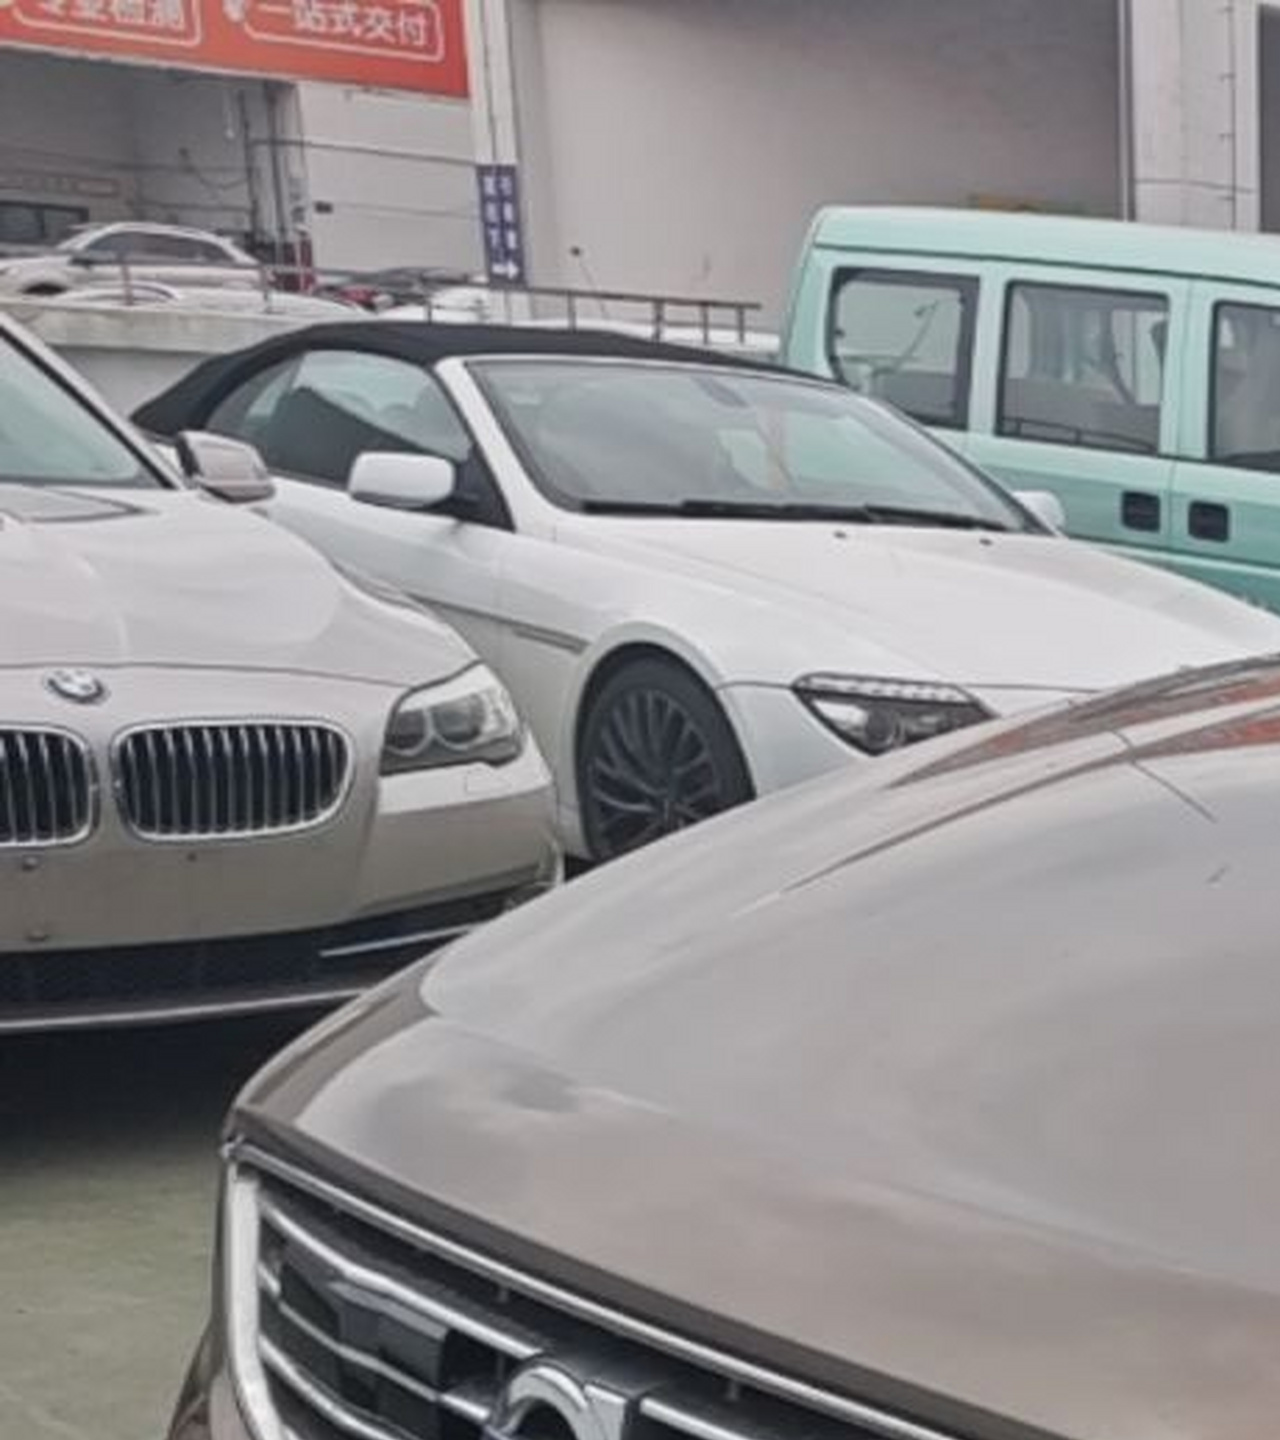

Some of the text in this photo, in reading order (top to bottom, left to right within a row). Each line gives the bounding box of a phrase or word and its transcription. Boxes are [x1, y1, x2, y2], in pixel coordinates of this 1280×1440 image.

[257, 0, 426, 46] 一站式交付
